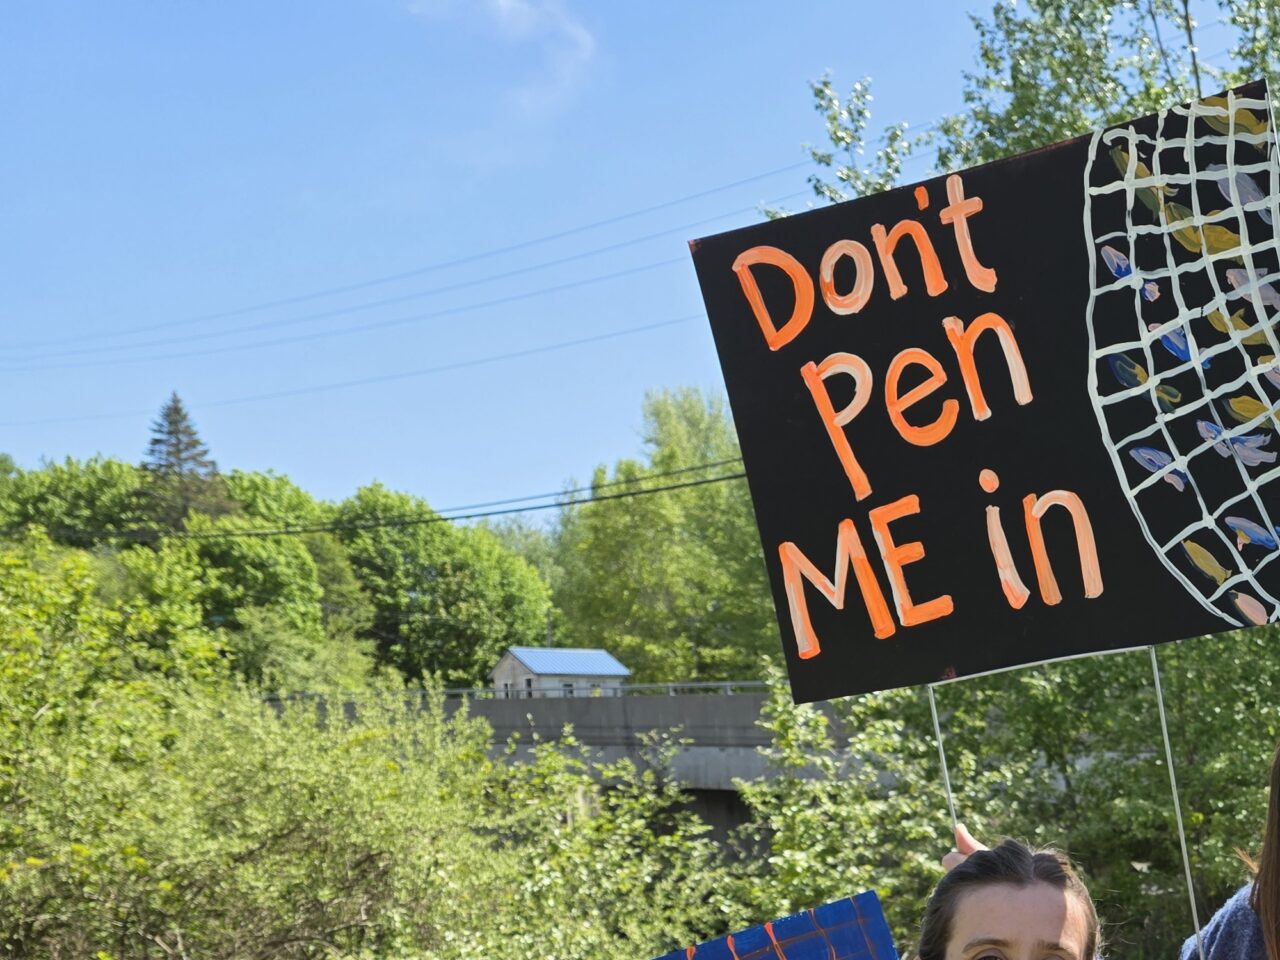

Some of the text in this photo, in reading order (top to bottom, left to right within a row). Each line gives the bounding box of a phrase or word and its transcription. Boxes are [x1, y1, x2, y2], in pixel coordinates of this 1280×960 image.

[732, 174, 998, 351] Don't
[778, 468, 1103, 660] ME in
